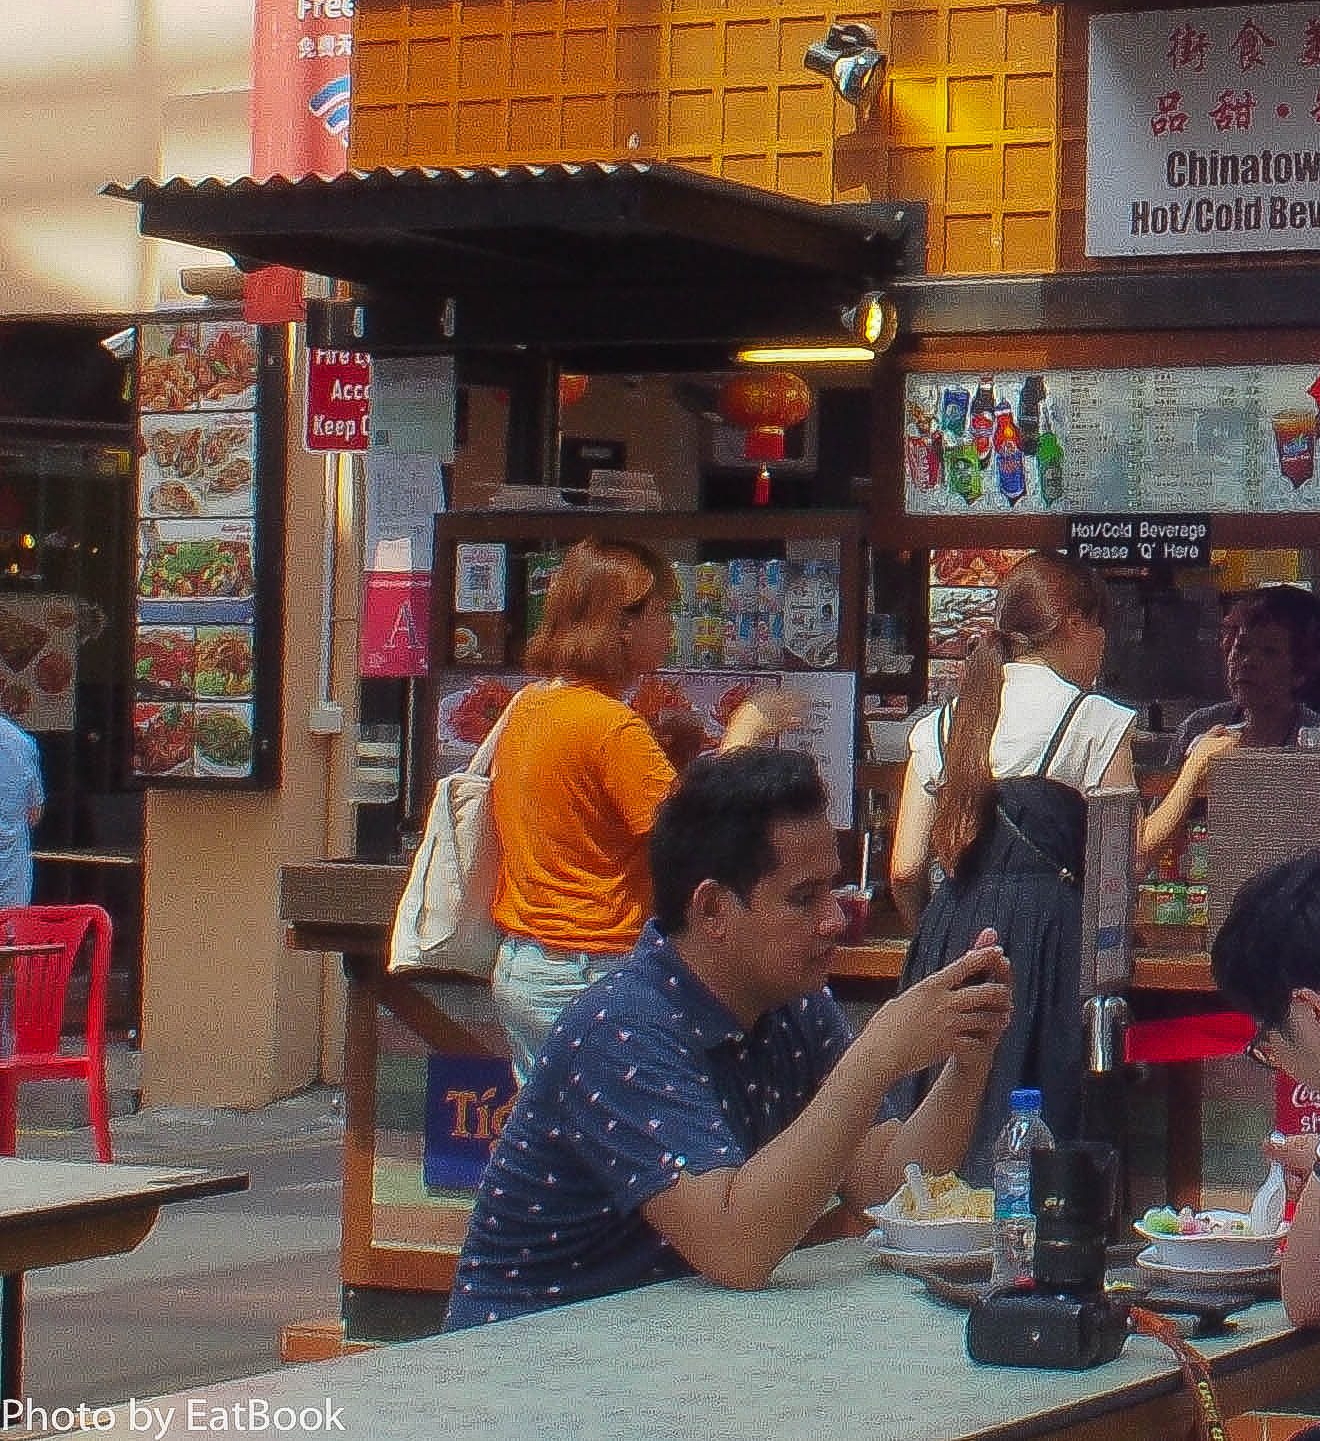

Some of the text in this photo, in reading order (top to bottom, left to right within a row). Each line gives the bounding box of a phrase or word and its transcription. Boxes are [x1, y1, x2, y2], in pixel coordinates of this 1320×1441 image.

[1130, 194, 1263, 237] Hot/Cold
[312, 413, 357, 442] Keep
[1071, 520, 1208, 541] Hot/Cold Beverage
[1079, 543, 1128, 559] Please
[1163, 542, 1199, 559] Here
[379, 599, 425, 649] A
